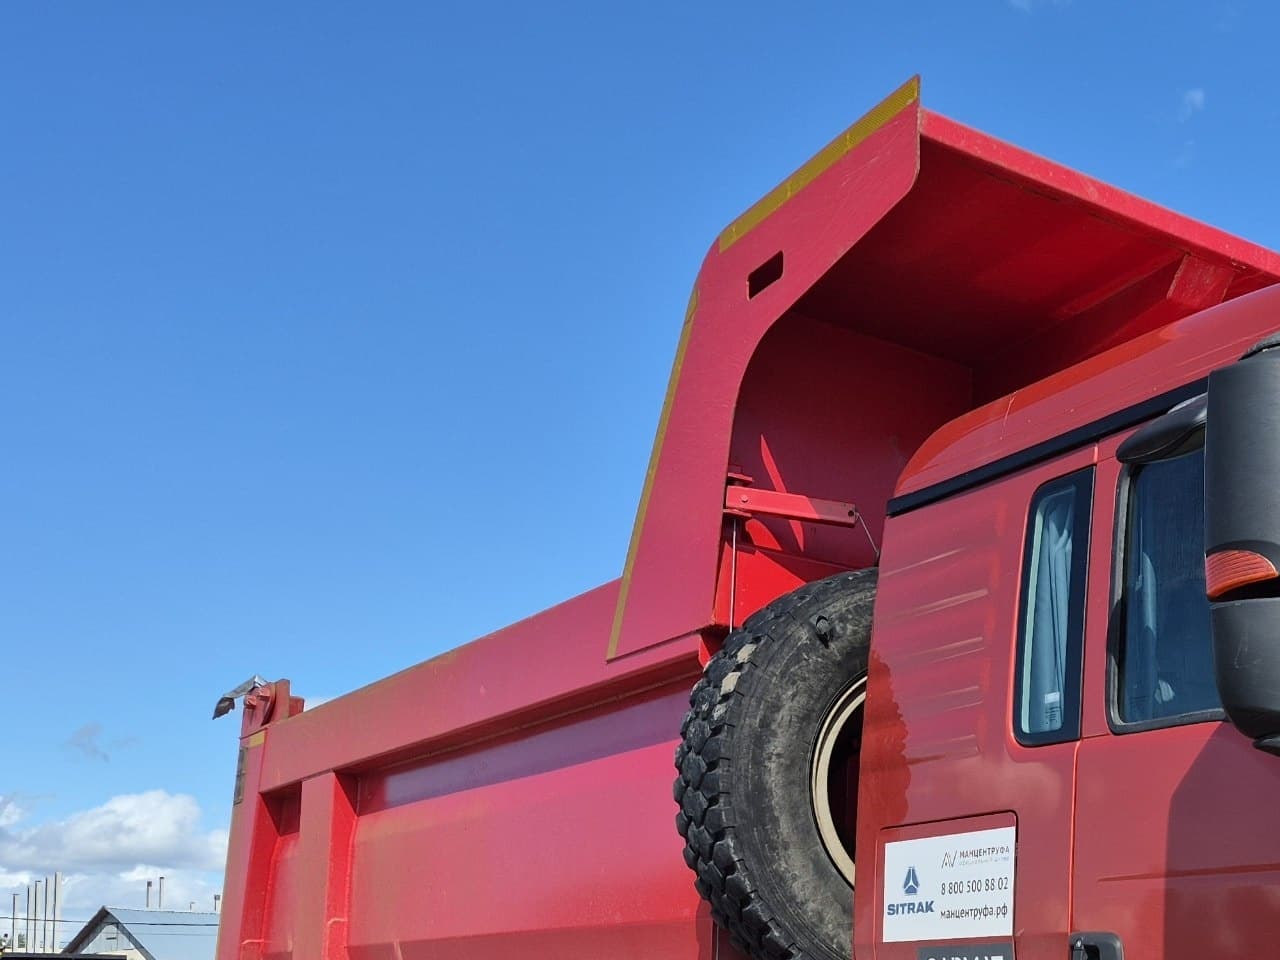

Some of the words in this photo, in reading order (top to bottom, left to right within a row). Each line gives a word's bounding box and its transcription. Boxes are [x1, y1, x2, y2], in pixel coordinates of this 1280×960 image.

[960, 845, 1010, 859] МАНЦЕНТРУФА
[948, 881, 964, 895] 800
[966, 879, 982, 893] 500
[984, 878, 996, 891] 88
[997, 877, 1009, 890] 02
[887, 900, 935, 916] SITRAK
[940, 902, 1008, 921] манцентруфа.рф
